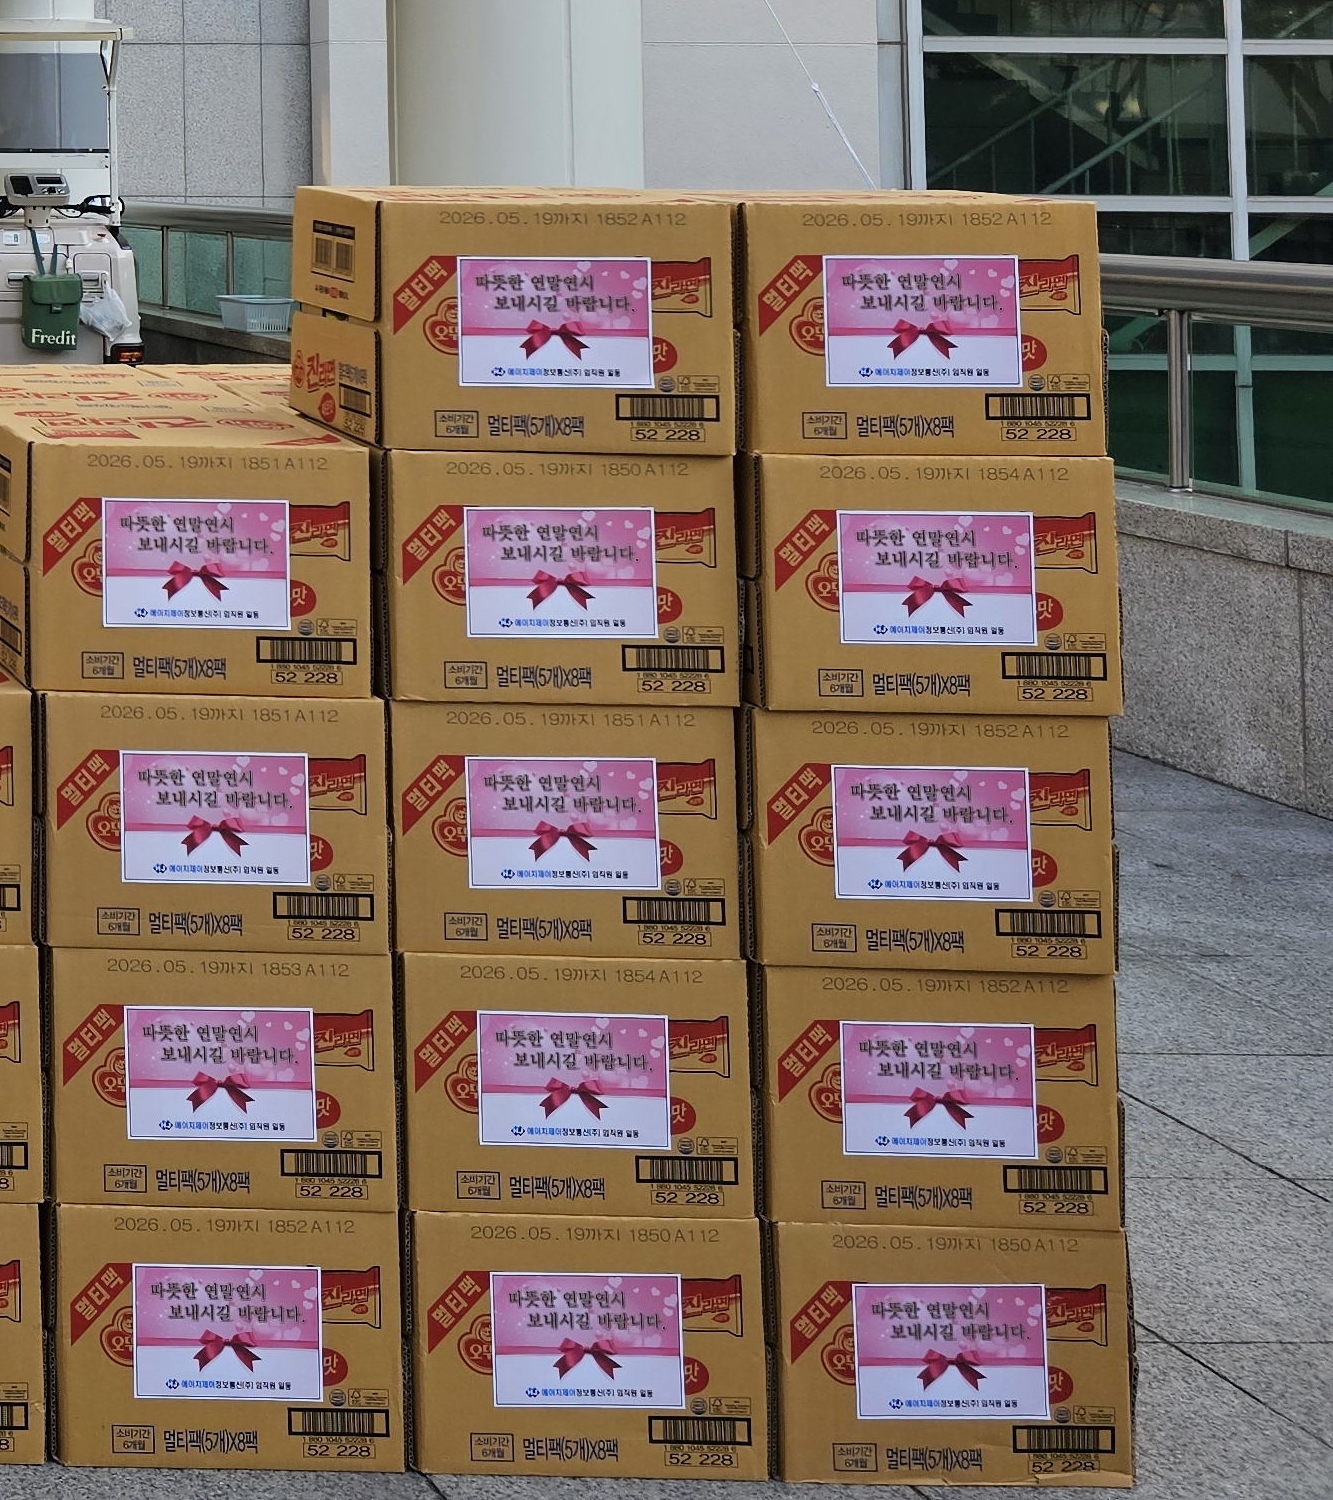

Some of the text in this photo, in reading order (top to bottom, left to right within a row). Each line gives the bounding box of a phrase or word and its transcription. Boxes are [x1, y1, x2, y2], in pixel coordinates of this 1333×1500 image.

[841, 272, 962, 291] 따뜻한 연말연시
[860, 293, 1004, 313] 보내시길 바랍니다.
[31, 328, 77, 345] Fredit
[636, 430, 701, 441] 52 228
[1005, 428, 1072, 441] 52 228
[871, 1301, 990, 1320] 따뜻한 연말연시
[890, 1323, 1030, 1341] 보내시길 바랍니다.
[1031, 1461, 1095, 1473] 52 228
